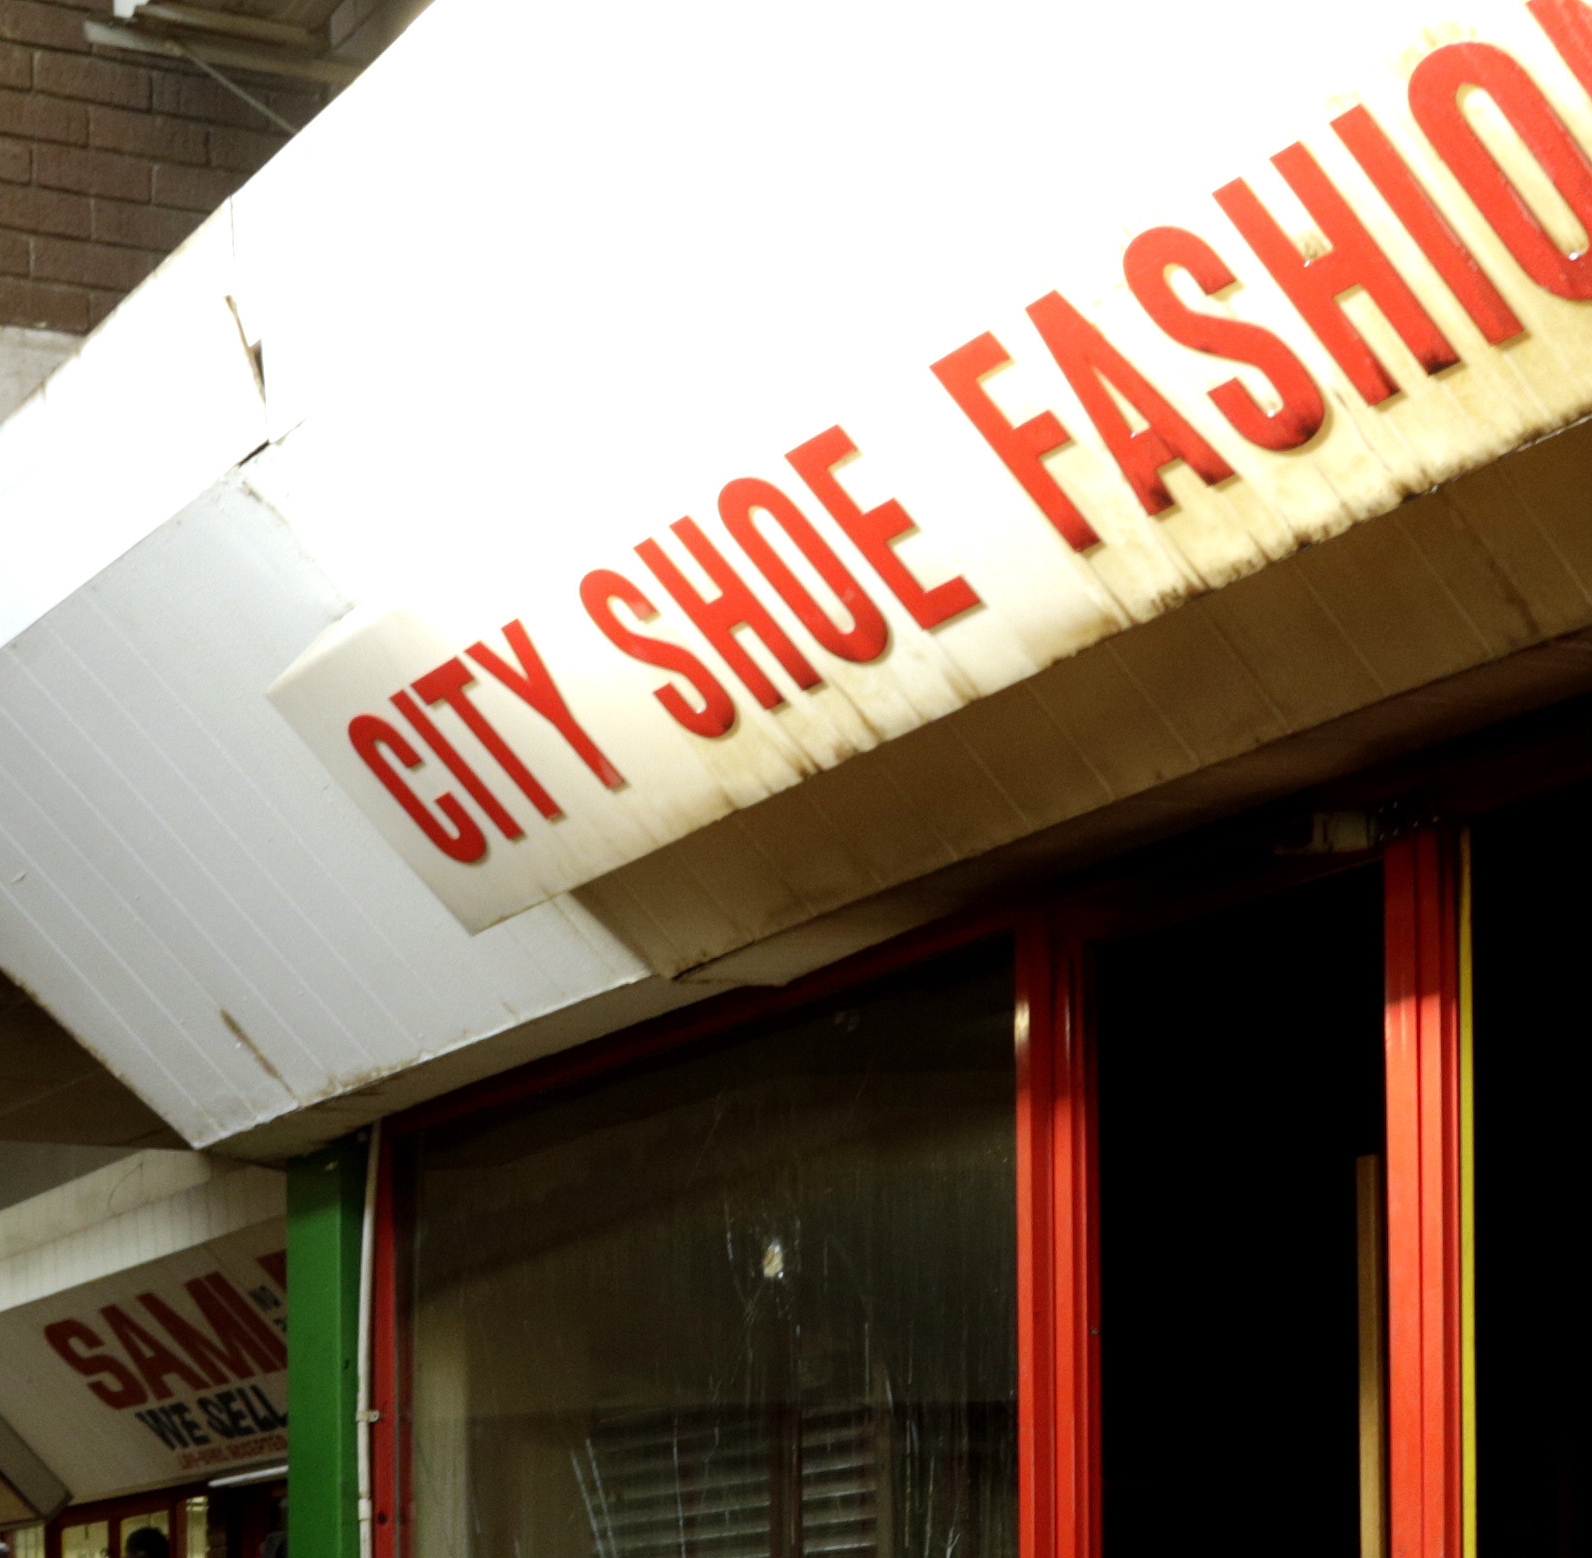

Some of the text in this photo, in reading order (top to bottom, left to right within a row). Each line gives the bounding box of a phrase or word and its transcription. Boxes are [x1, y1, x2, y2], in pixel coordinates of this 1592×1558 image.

[348, 619, 624, 863] CITY
[579, 424, 983, 740] SHOE
[134, 1401, 211, 1452] WE
